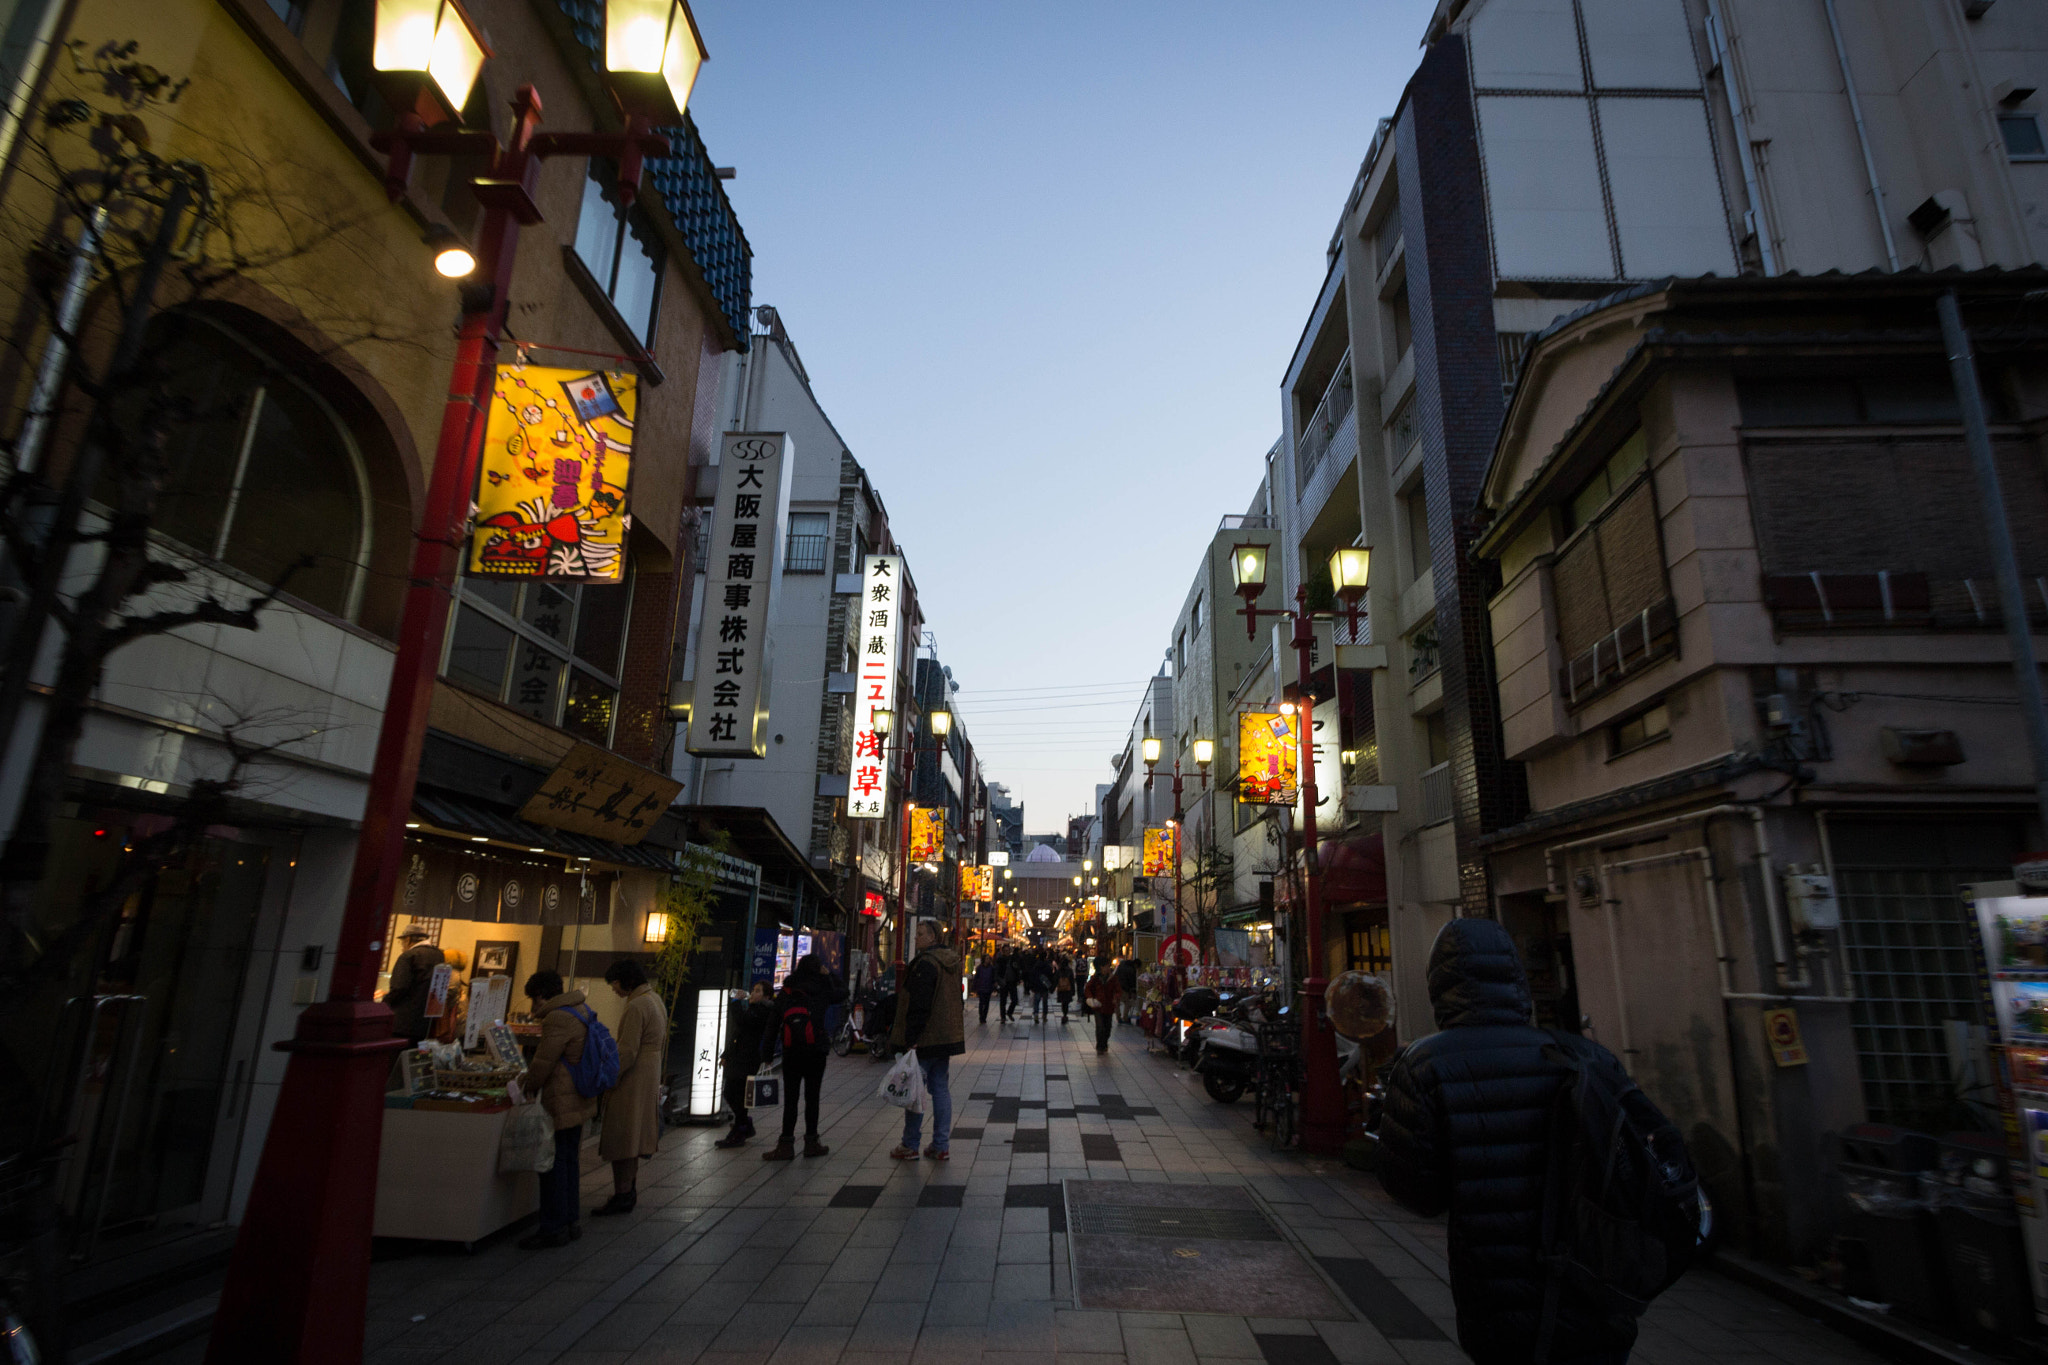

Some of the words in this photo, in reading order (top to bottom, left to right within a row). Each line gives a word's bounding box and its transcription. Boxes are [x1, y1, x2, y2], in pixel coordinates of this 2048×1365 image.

[709, 464, 764, 742] 大阪屋商事株式会社
[852, 800, 880, 813] 本店
[697, 1049, 711, 1079] 丸仁
